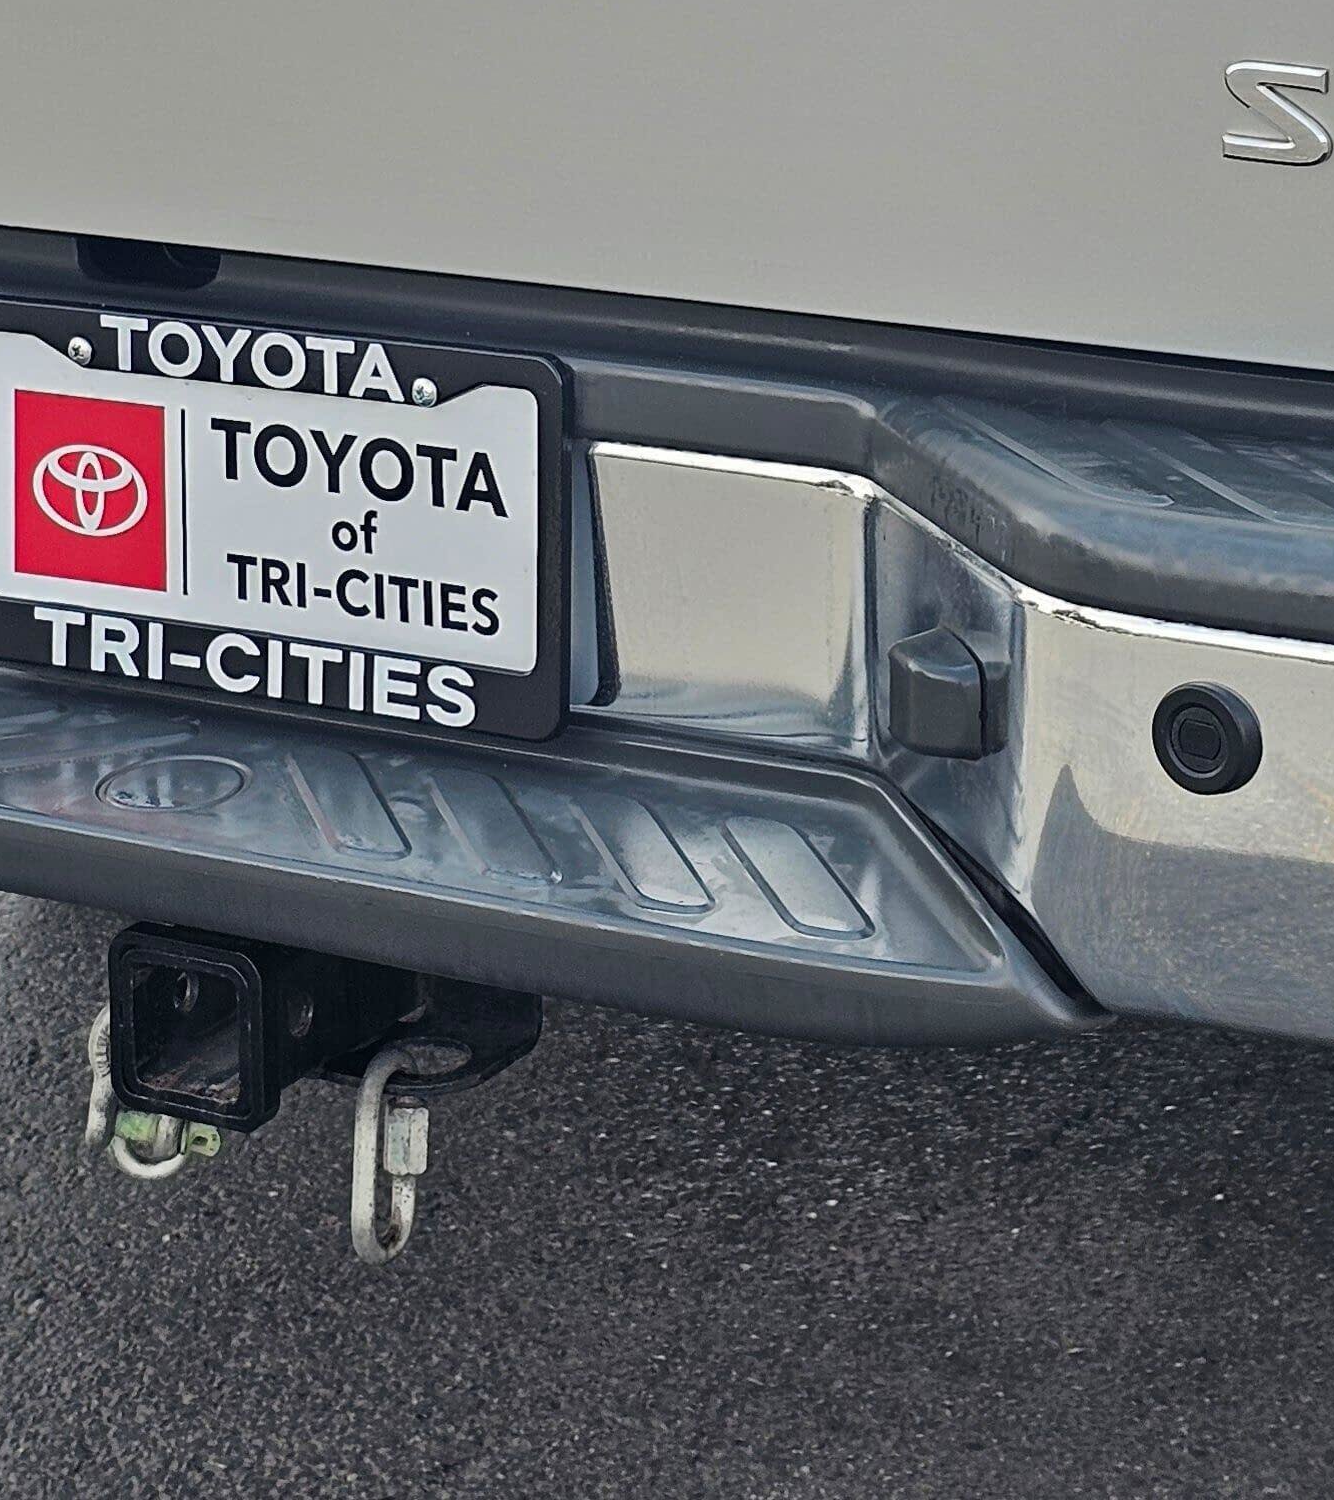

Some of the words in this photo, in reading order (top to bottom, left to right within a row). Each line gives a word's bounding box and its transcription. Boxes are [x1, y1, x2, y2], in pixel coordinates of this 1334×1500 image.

[100, 314, 405, 403] TOYOTA
[210, 417, 509, 518] TOYOTA
[331, 510, 378, 555] of
[226, 553, 500, 637] TRI-CITIES
[33, 607, 476, 728] TRI-CITIES
